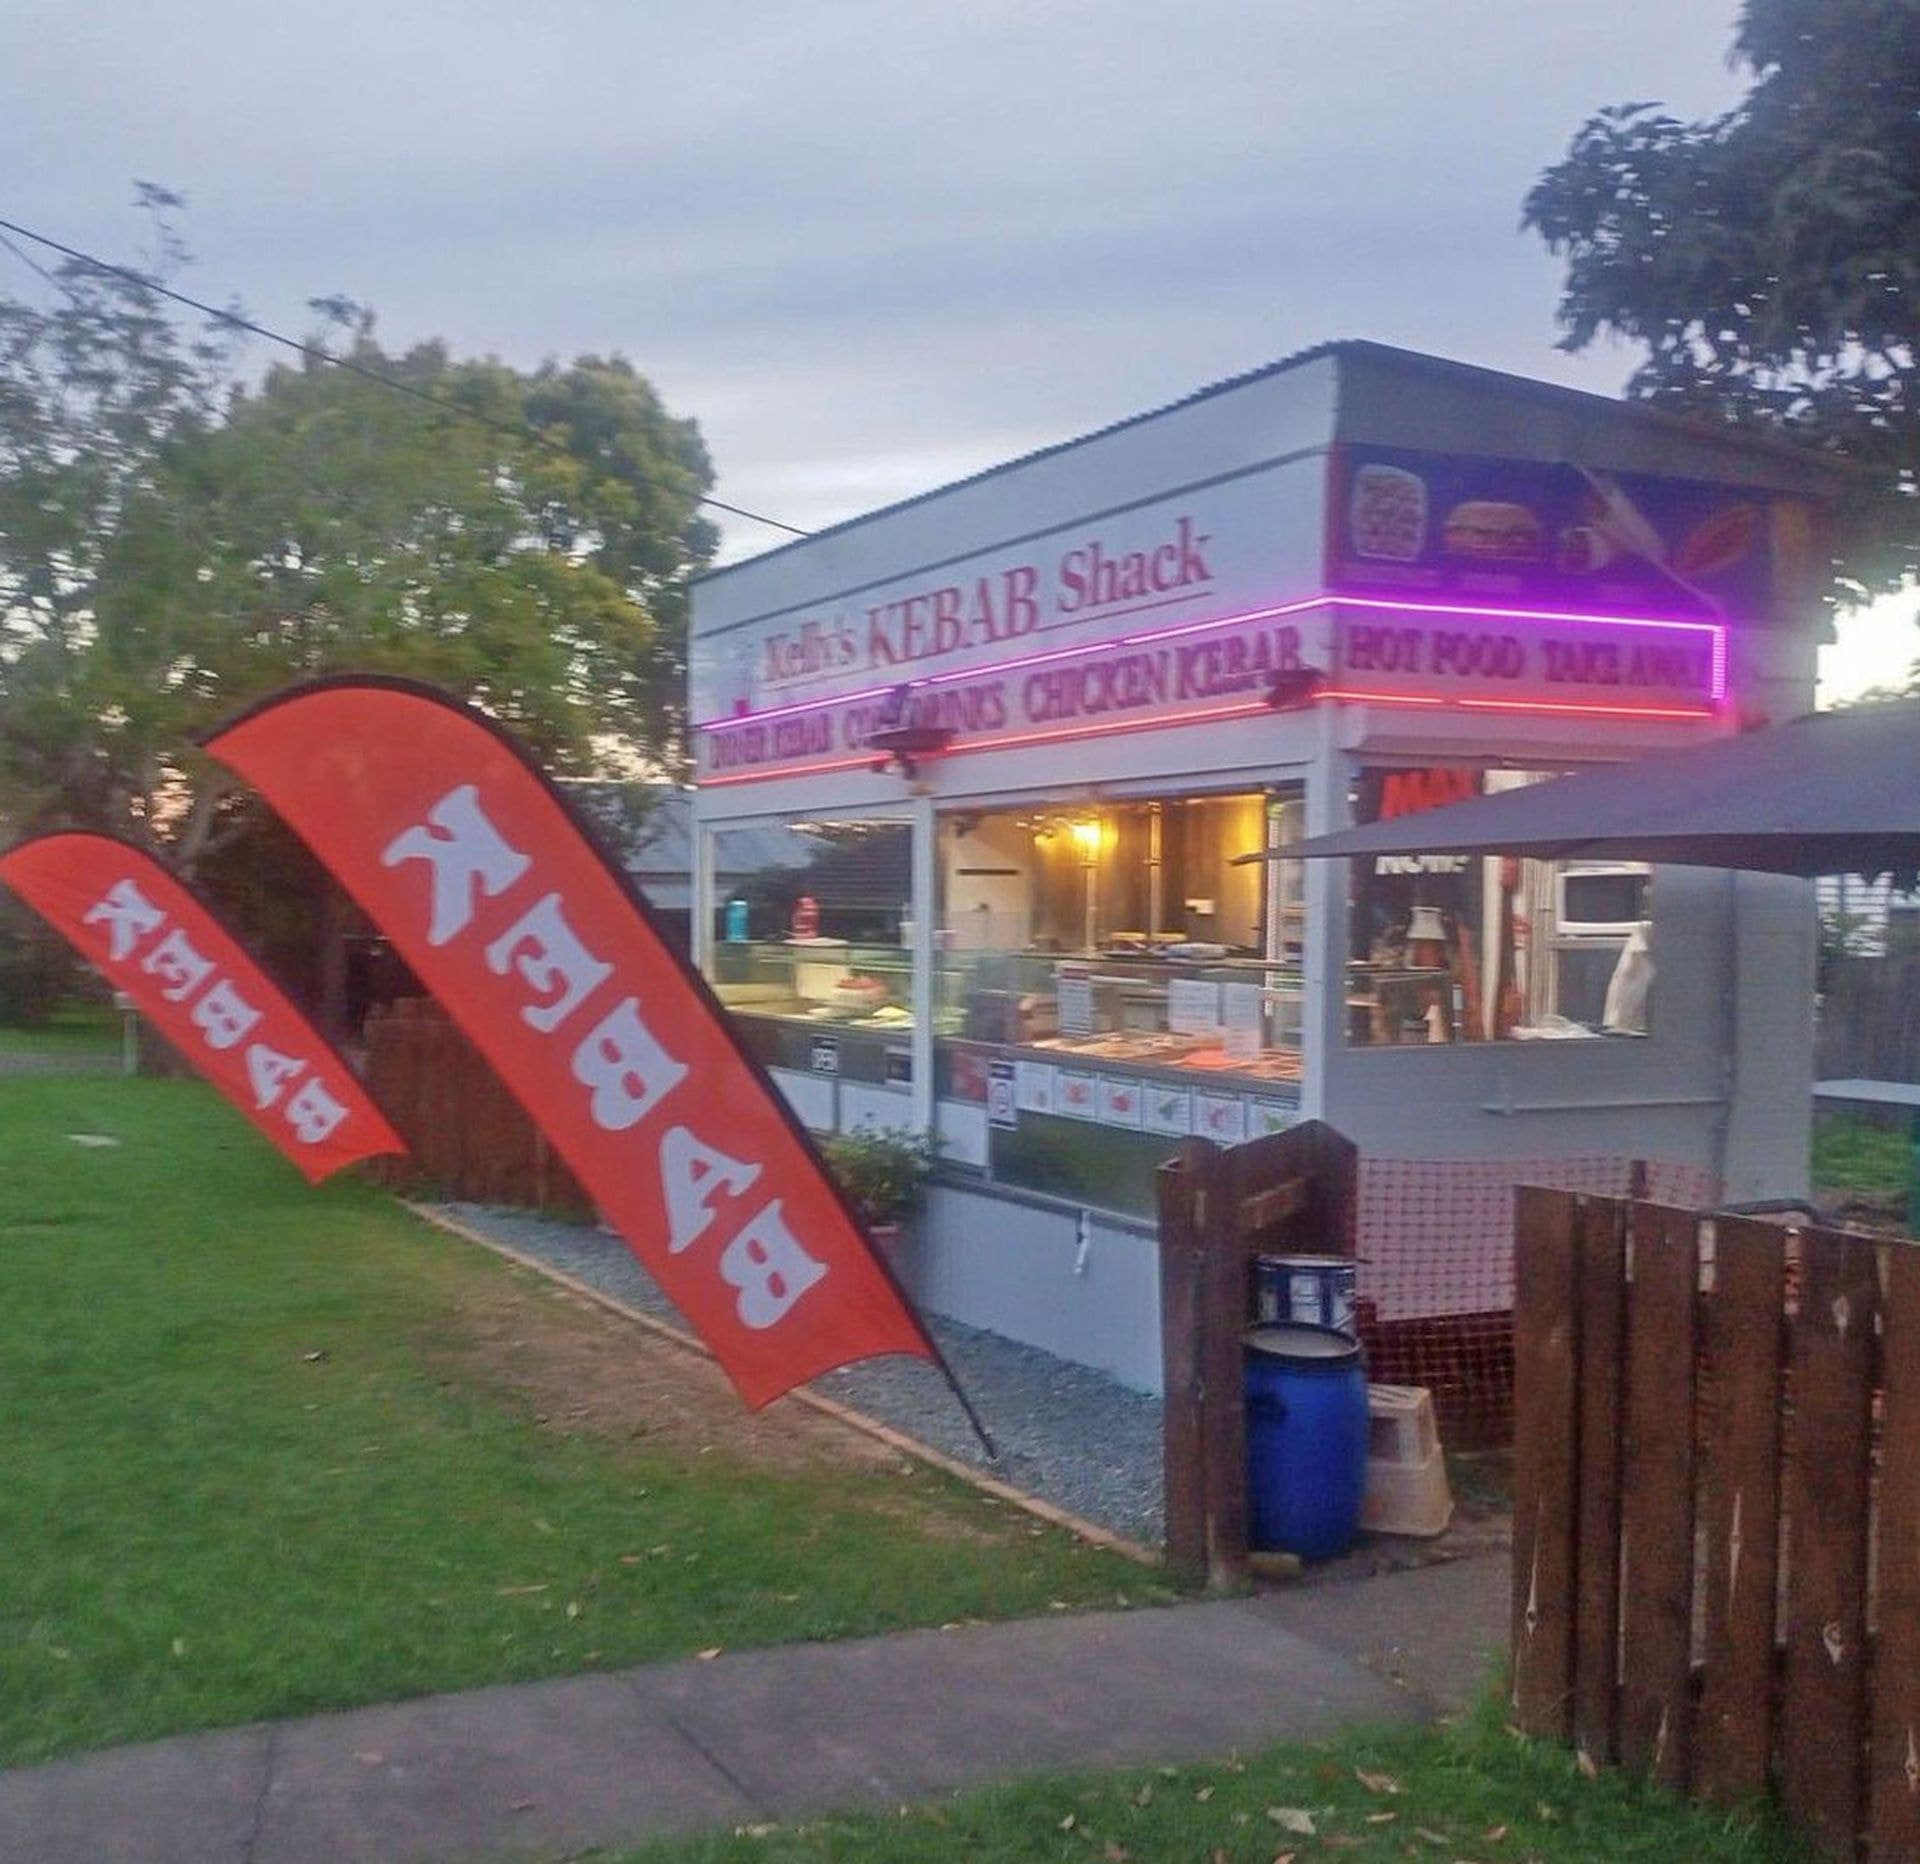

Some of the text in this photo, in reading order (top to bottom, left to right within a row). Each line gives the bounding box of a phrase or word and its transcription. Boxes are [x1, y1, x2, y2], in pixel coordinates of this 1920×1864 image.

[865, 564, 1041, 670] KEBAB
[1056, 515, 1214, 614] Shack
[1347, 623, 1424, 674] HOT
[1431, 628, 1527, 680] FOOD
[1024, 652, 1170, 723] CHICKEN
